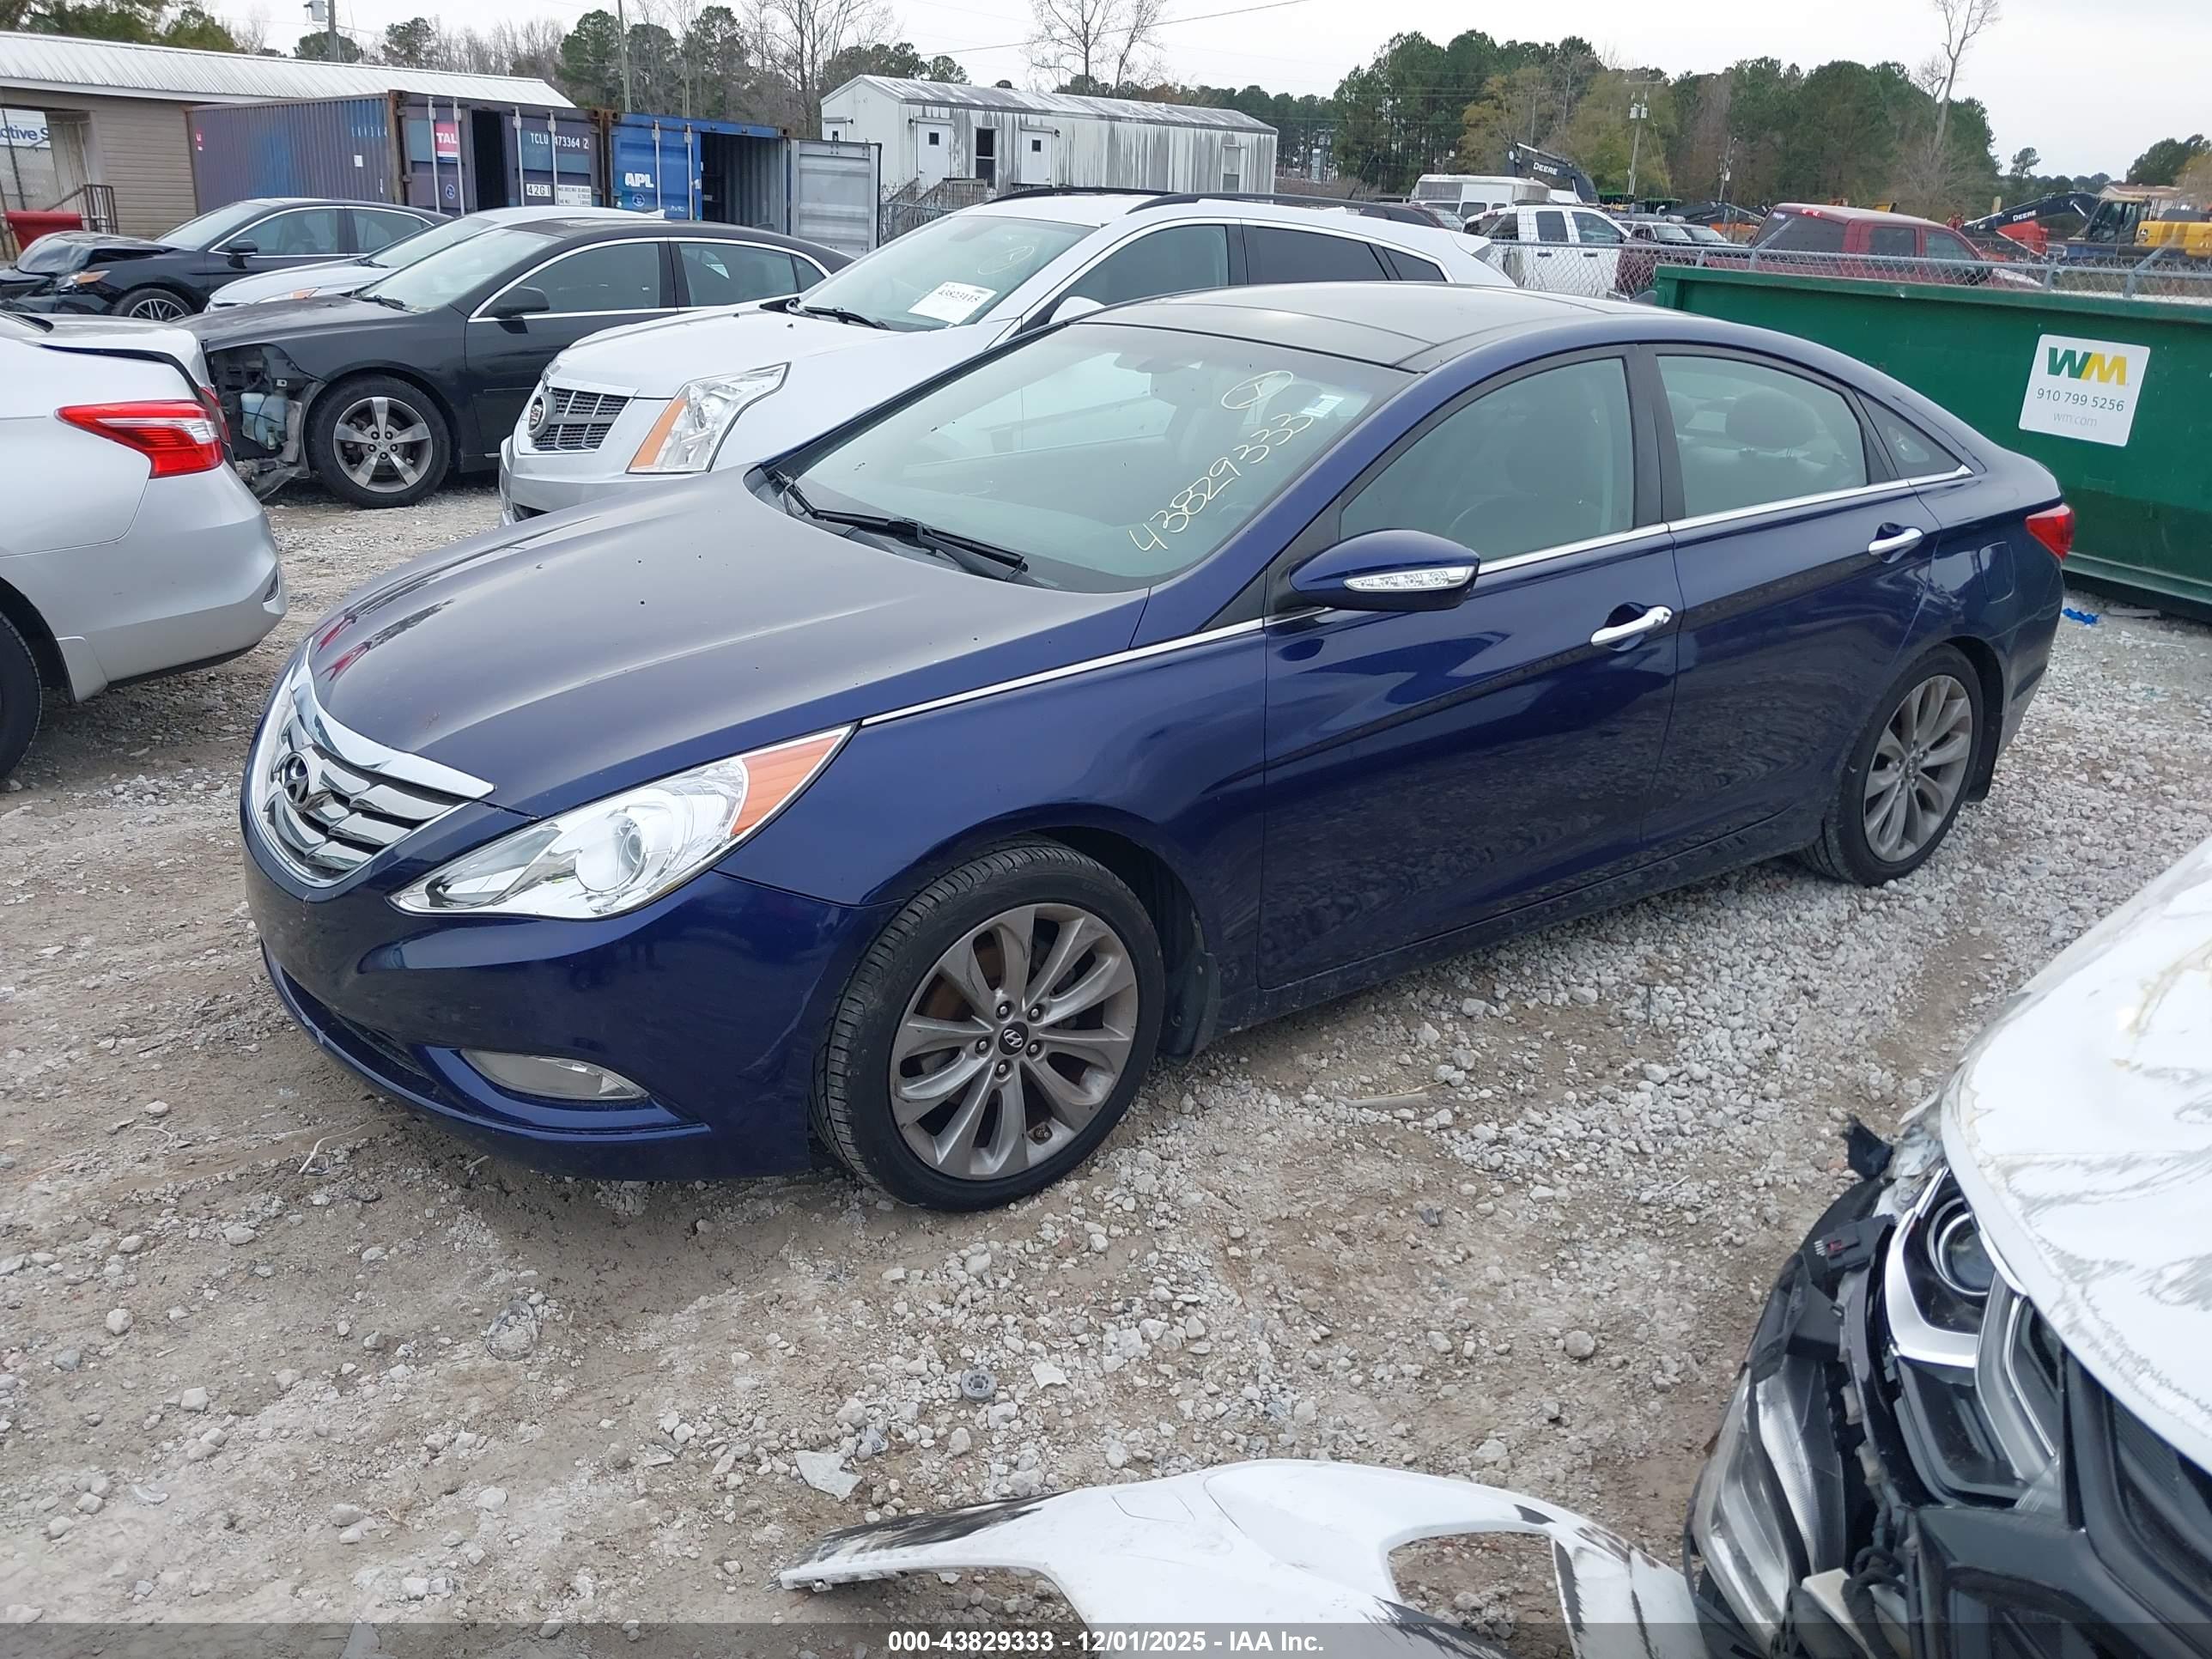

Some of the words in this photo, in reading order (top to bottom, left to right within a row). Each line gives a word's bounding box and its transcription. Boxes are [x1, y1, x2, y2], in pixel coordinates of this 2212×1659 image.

[436, 131, 458, 144] TAL
[530, 132, 549, 144] TCLU
[1533, 161, 1559, 176] DEERE
[624, 173, 654, 188] APL
[2012, 210, 2037, 222] DEERE
[2047, 346, 2128, 386] WM
[2036, 387, 2061, 402] 910
[2063, 392, 2088, 406] 799
[2091, 396, 2124, 412] 5256
[1128, 413, 1314, 551] 43829333
